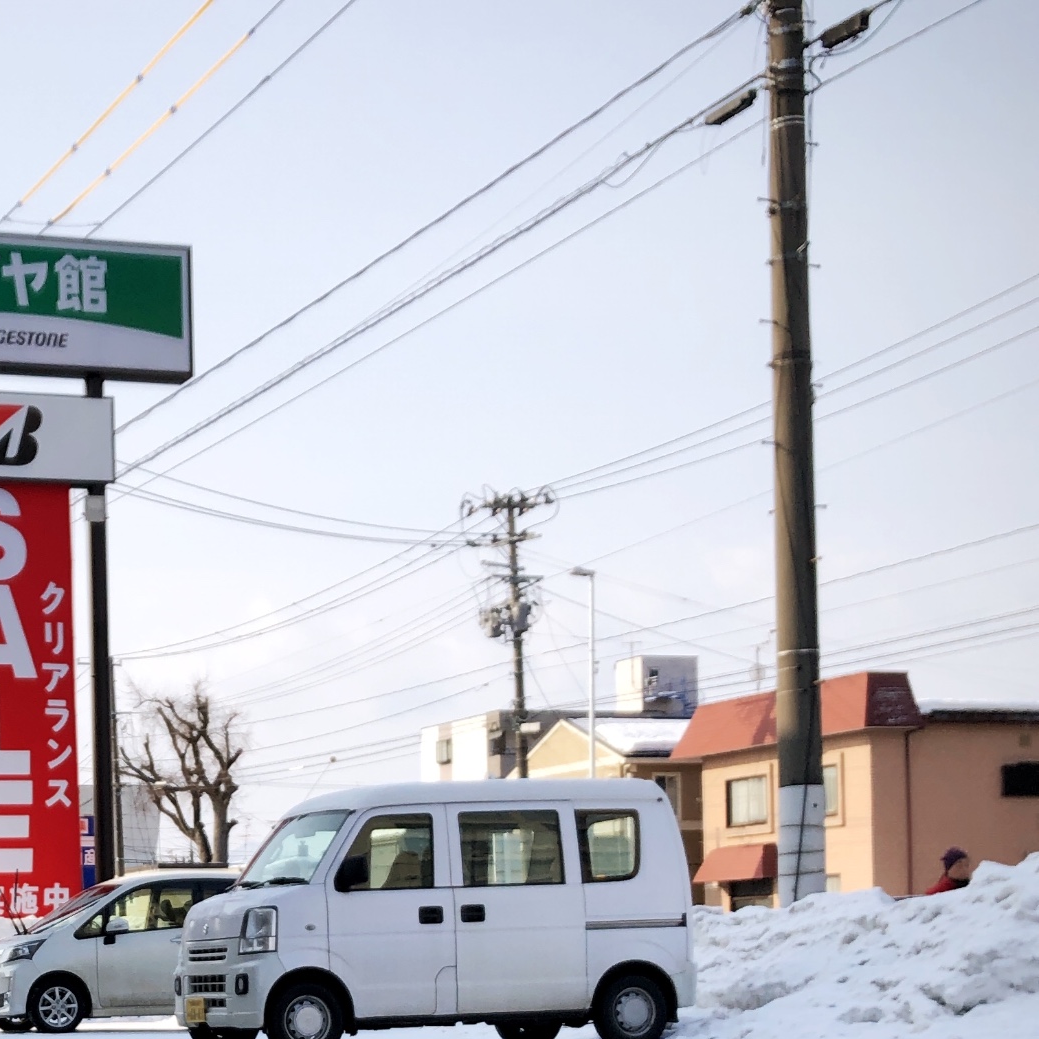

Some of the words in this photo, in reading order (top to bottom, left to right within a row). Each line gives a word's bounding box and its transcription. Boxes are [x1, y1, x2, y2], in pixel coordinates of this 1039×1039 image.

[40, 581, 73, 808] クリアランス
